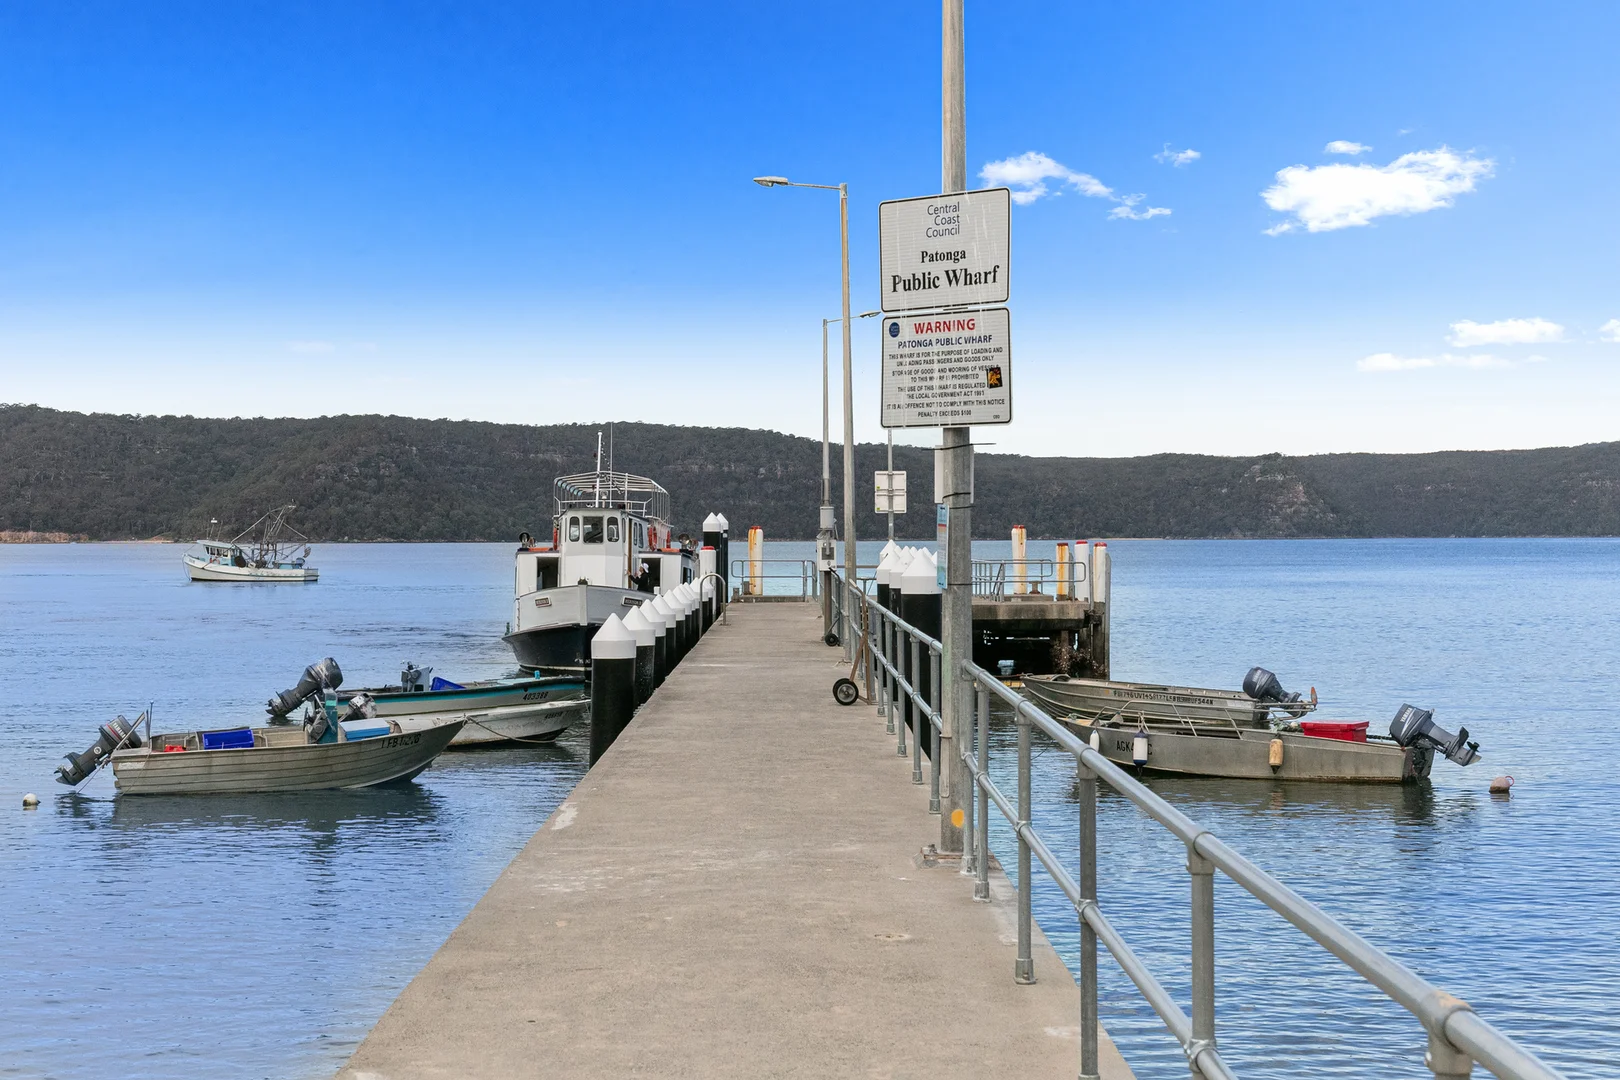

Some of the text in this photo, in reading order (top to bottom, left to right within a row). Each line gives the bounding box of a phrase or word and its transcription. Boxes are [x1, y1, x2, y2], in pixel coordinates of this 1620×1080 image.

[927, 202, 960, 216] Central
[934, 215, 960, 226] Coast
[926, 224, 960, 238] Council
[920, 250, 966, 263] Patonga
[892, 265, 1000, 292] Public Wharf
[914, 318, 976, 334] WARNING
[898, 335, 992, 349] PATONGA PUBLIC WHARF
